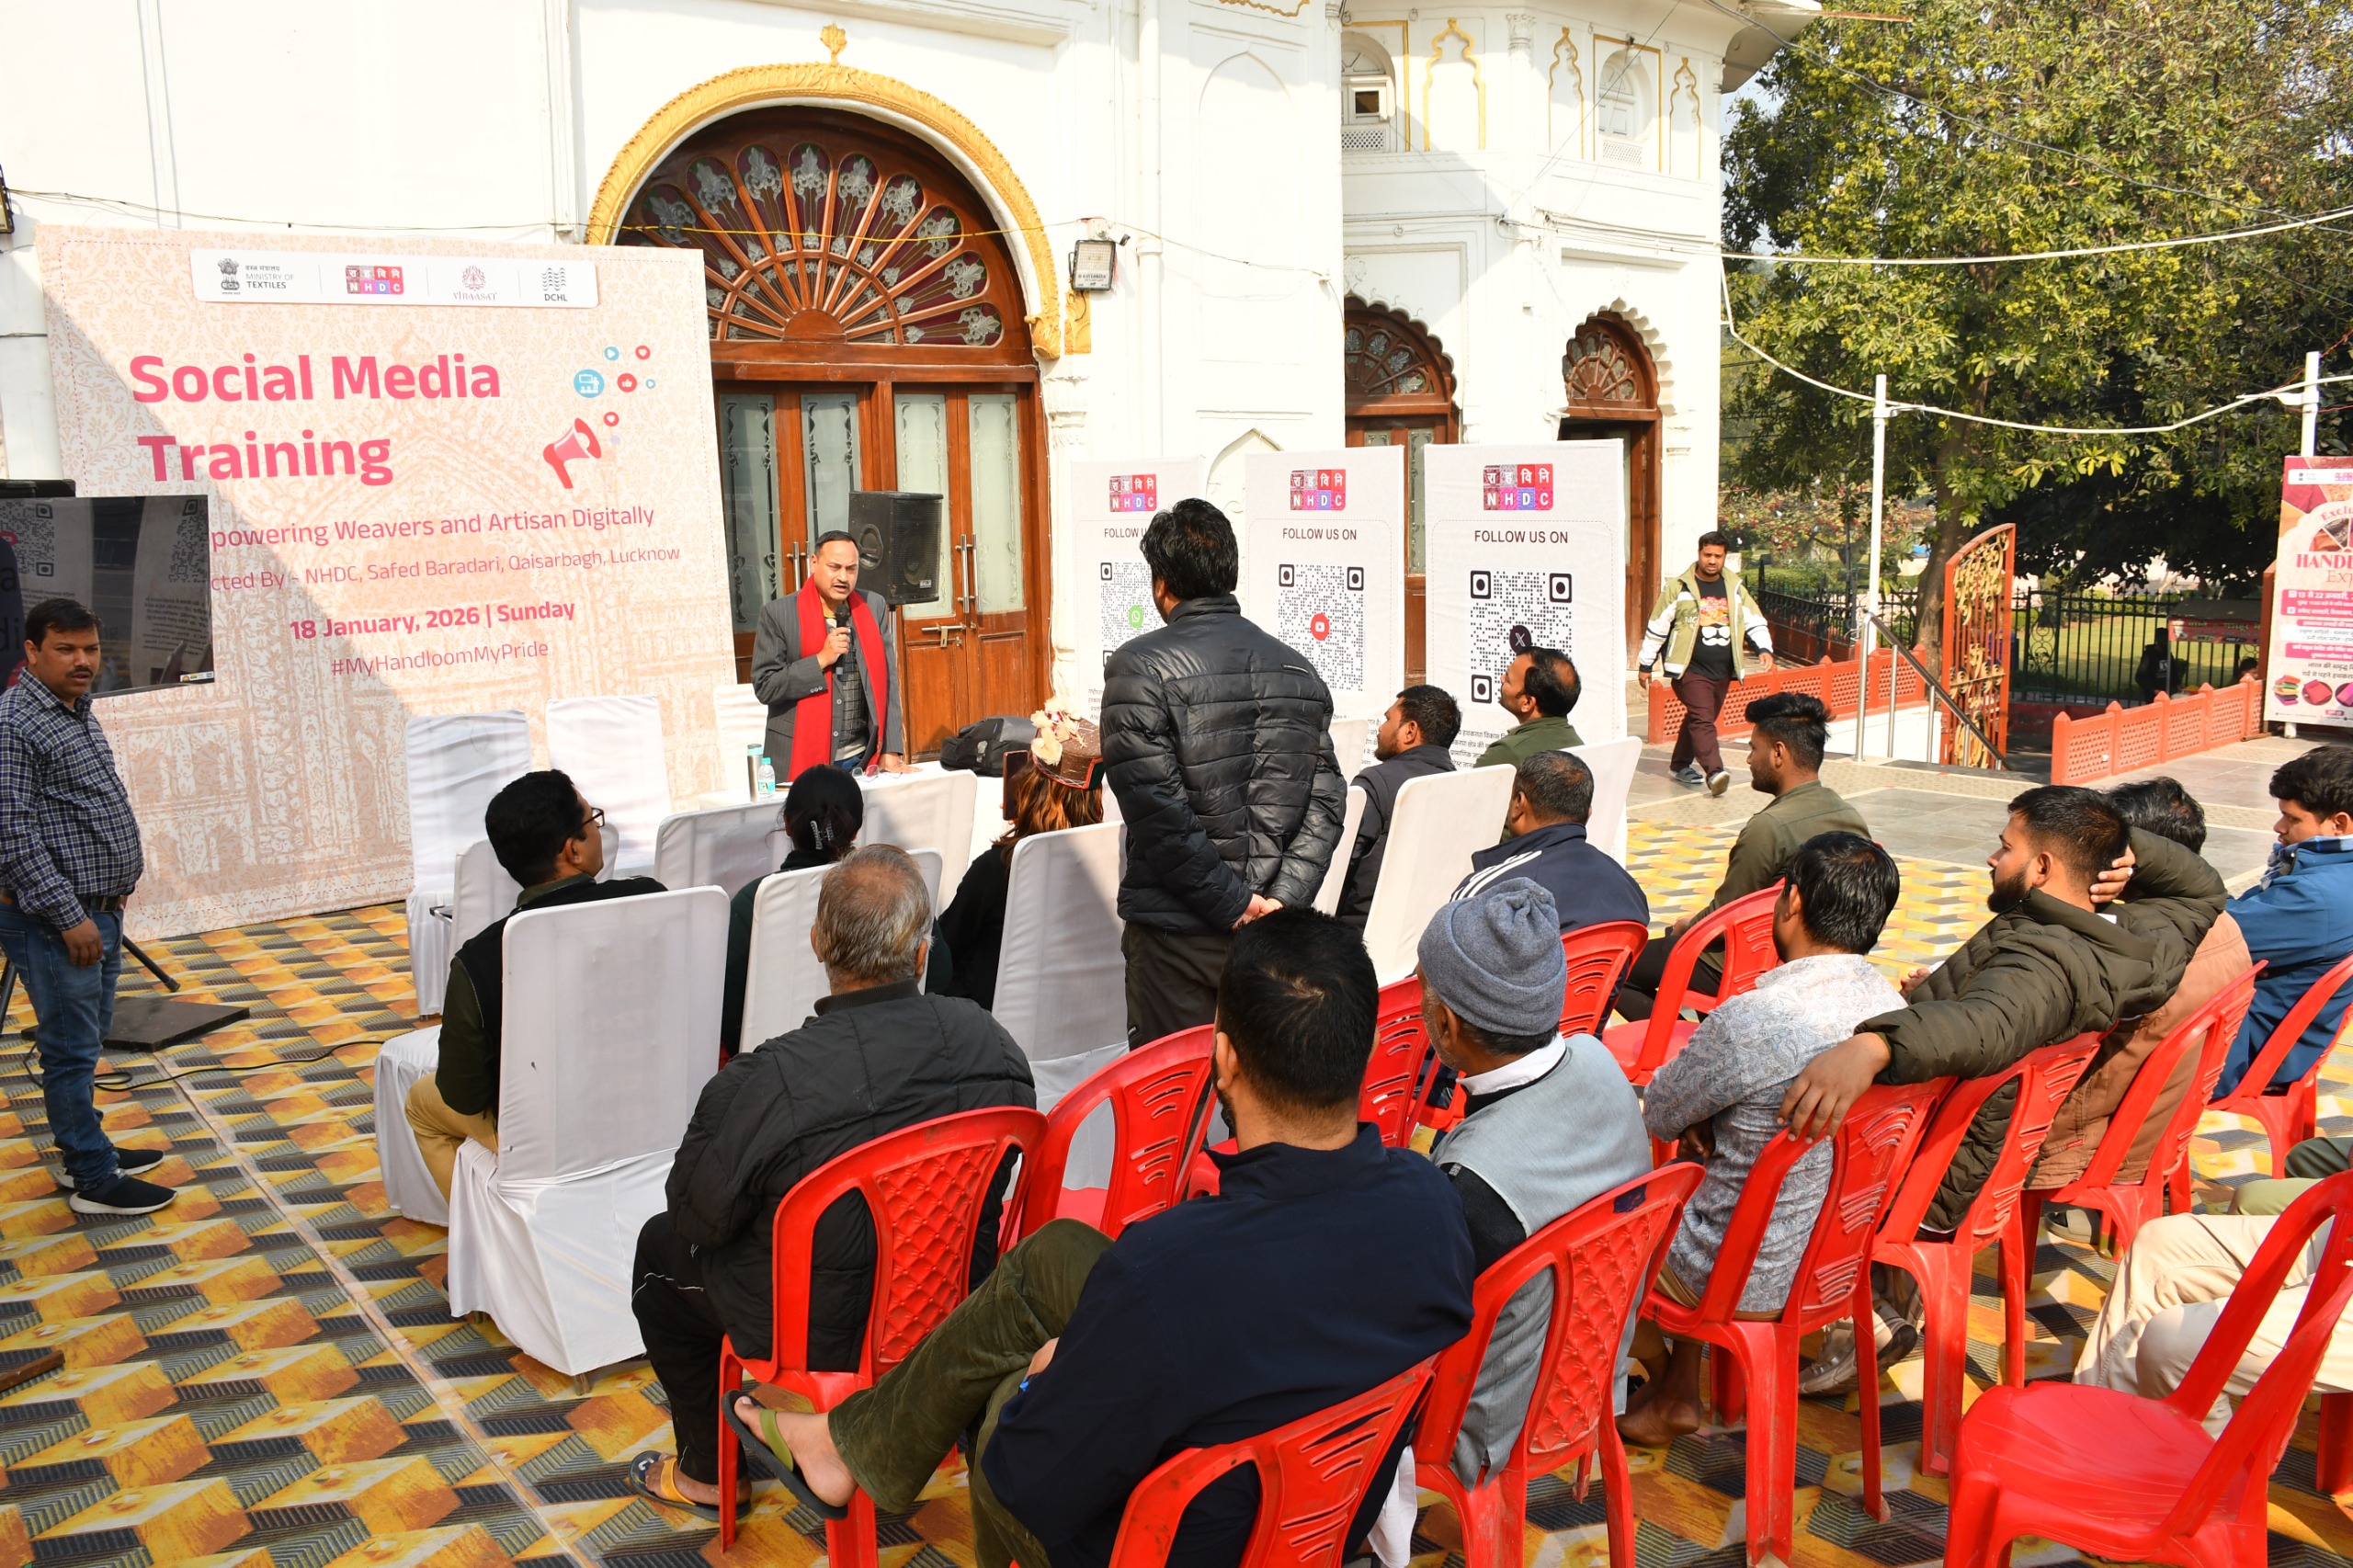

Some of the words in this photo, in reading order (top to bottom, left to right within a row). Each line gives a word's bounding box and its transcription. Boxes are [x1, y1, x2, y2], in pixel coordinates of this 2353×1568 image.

[246, 280, 287, 290] TEXTILES
[453, 291, 497, 301] VIRAASAT
[544, 293, 568, 301] DCHL
[130, 352, 314, 403] Social
[331, 352, 501, 401] Media
[137, 428, 394, 487] Training
[211, 523, 329, 552] powering
[335, 519, 435, 540] Weavers
[440, 514, 482, 535] and
[488, 510, 566, 532] Artisan
[573, 506, 654, 531] Digitally
[1104, 528, 1140, 539] FOLLOW
[1141, 528, 1147, 539] U
[1282, 528, 1324, 540] FOLLOW
[1325, 528, 1340, 540] US
[1342, 528, 1358, 540] ON
[1474, 529, 1526, 543] FOLLOW
[1529, 530, 1546, 543] US
[1550, 530, 1569, 544] ON
[210, 572, 255, 591] cted
[261, 570, 285, 590] By
[305, 565, 363, 585] NHDC,
[368, 561, 421, 581] Safed
[426, 555, 505, 576] Baradari,
[508, 550, 607, 571] Qaisarbagh,
[610, 547, 681, 564] Lucknow
[290, 619, 317, 640] 18
[323, 614, 421, 638] January,
[426, 607, 480, 629] 2026
[497, 600, 576, 622] Sunday
[331, 641, 550, 677] #MyHandloomMyPride
